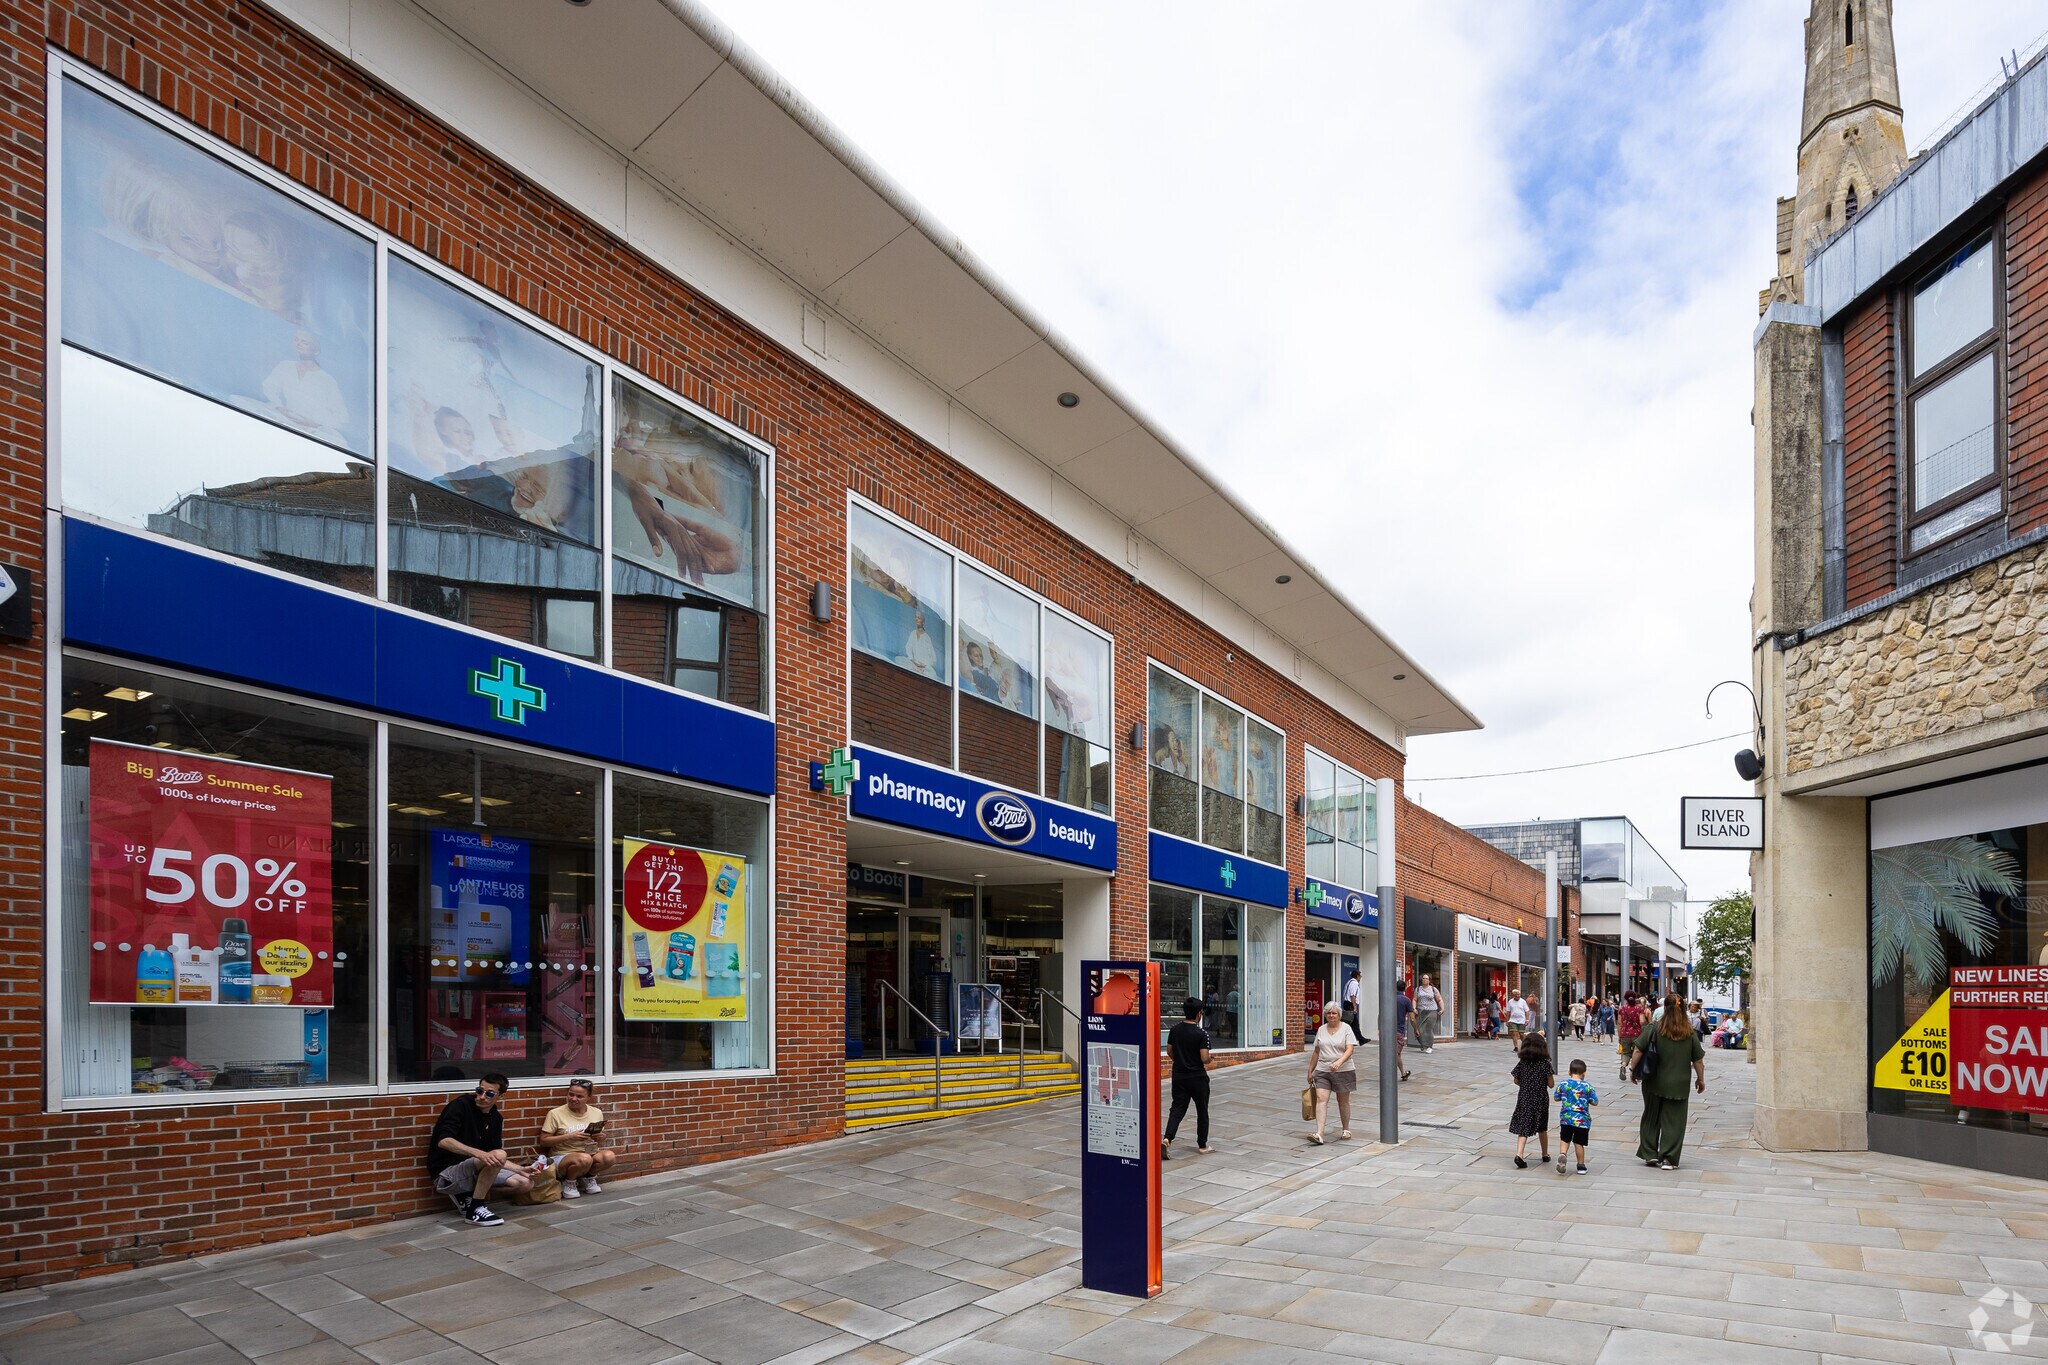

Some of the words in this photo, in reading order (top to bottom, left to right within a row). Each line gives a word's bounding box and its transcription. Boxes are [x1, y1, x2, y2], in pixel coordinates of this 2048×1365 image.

[126, 762, 153, 778] Big
[157, 767, 203, 784] Boots
[207, 774, 270, 794] Summer
[273, 784, 303, 799] Sale
[159, 787, 193, 801] 1000s
[196, 793, 209, 802] of
[211, 794, 242, 808] lower
[245, 799, 277, 812] prices
[869, 773, 966, 818] pharmacy
[988, 802, 1027, 830] Boots
[1701, 809, 1745, 823] RIVER
[1049, 818, 1096, 850] beauty
[1696, 824, 1750, 838] ISLAND
[124, 844, 146, 853] UP
[124, 854, 146, 863] TO
[652, 855, 670, 863] BUY
[644, 860, 662, 869] GET
[666, 863, 684, 872] 2ND
[146, 847, 306, 908] 50%
[646, 868, 682, 894] 1/2
[457, 878, 525, 892] ANTHELIOS
[502, 890, 525, 899] 400
[647, 891, 682, 902] PRICE
[255, 897, 307, 914] OFF
[1320, 895, 1342, 910] rmacy
[1468, 928, 1488, 946] NEW
[1492, 934, 1512, 952] LOOK
[274, 945, 299, 953] Hurry!
[280, 960, 308, 968] sizzling
[1954, 969, 1993, 983] NEW
[1997, 968, 2048, 982] LINES
[254, 988, 284, 996] OLAY
[1953, 991, 2019, 1003] FURTHER
[1088, 1023, 1106, 1031] WALK
[1923, 1027, 1947, 1037] SALE
[1900, 1038, 1947, 1050] BOTTOMS
[1900, 1050, 1947, 1077] £10
[1909, 1078, 1923, 1088] OR
[1925, 1080, 1947, 1090] LESS
[1957, 1061, 2048, 1098] NOW
